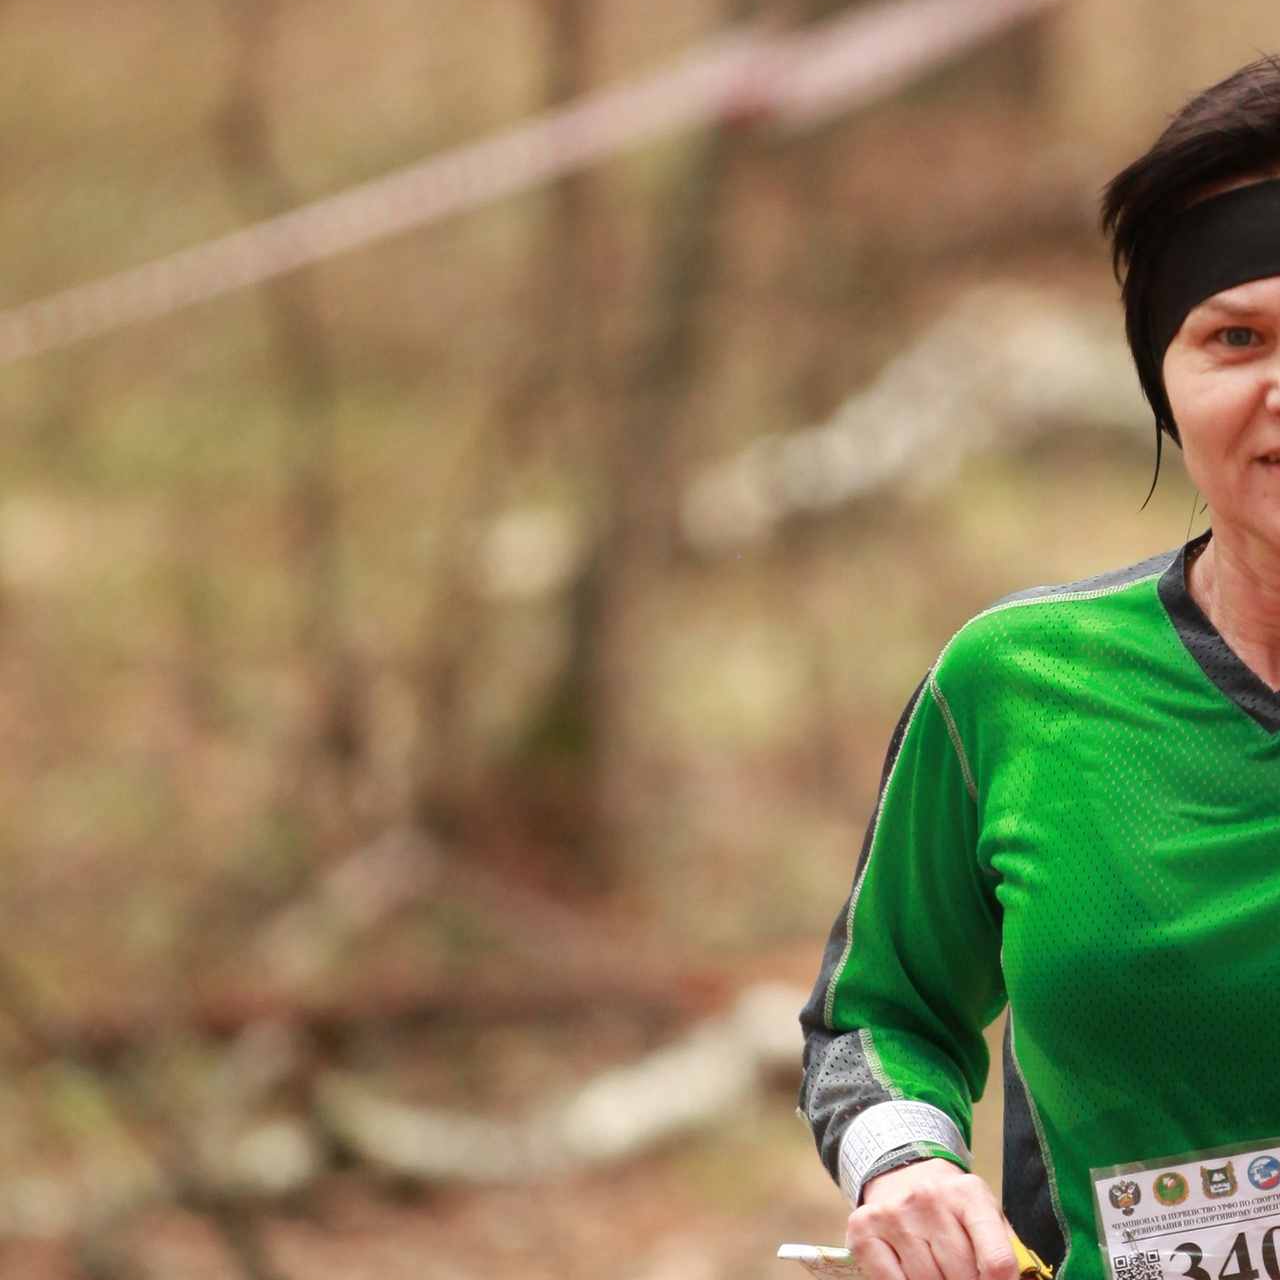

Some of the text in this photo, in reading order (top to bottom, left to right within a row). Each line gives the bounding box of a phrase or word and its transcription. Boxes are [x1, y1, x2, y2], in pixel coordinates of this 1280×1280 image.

[1111, 1216, 1159, 1230] ЧЕМПИОНАТ
[1160, 1214, 1168, 1222] И
[1168, 1205, 1216, 1219] ПЕРВЕНСТВО
[1217, 1201, 1239, 1211] УРФО
[1240, 1200, 1251, 1208] ПО
[1122, 1222, 1182, 1238] СРЕВНОВАНИЯ
[1183, 1219, 1195, 1227] ПО
[1195, 1209, 1251, 1225] СПОРТИВНОМУ
